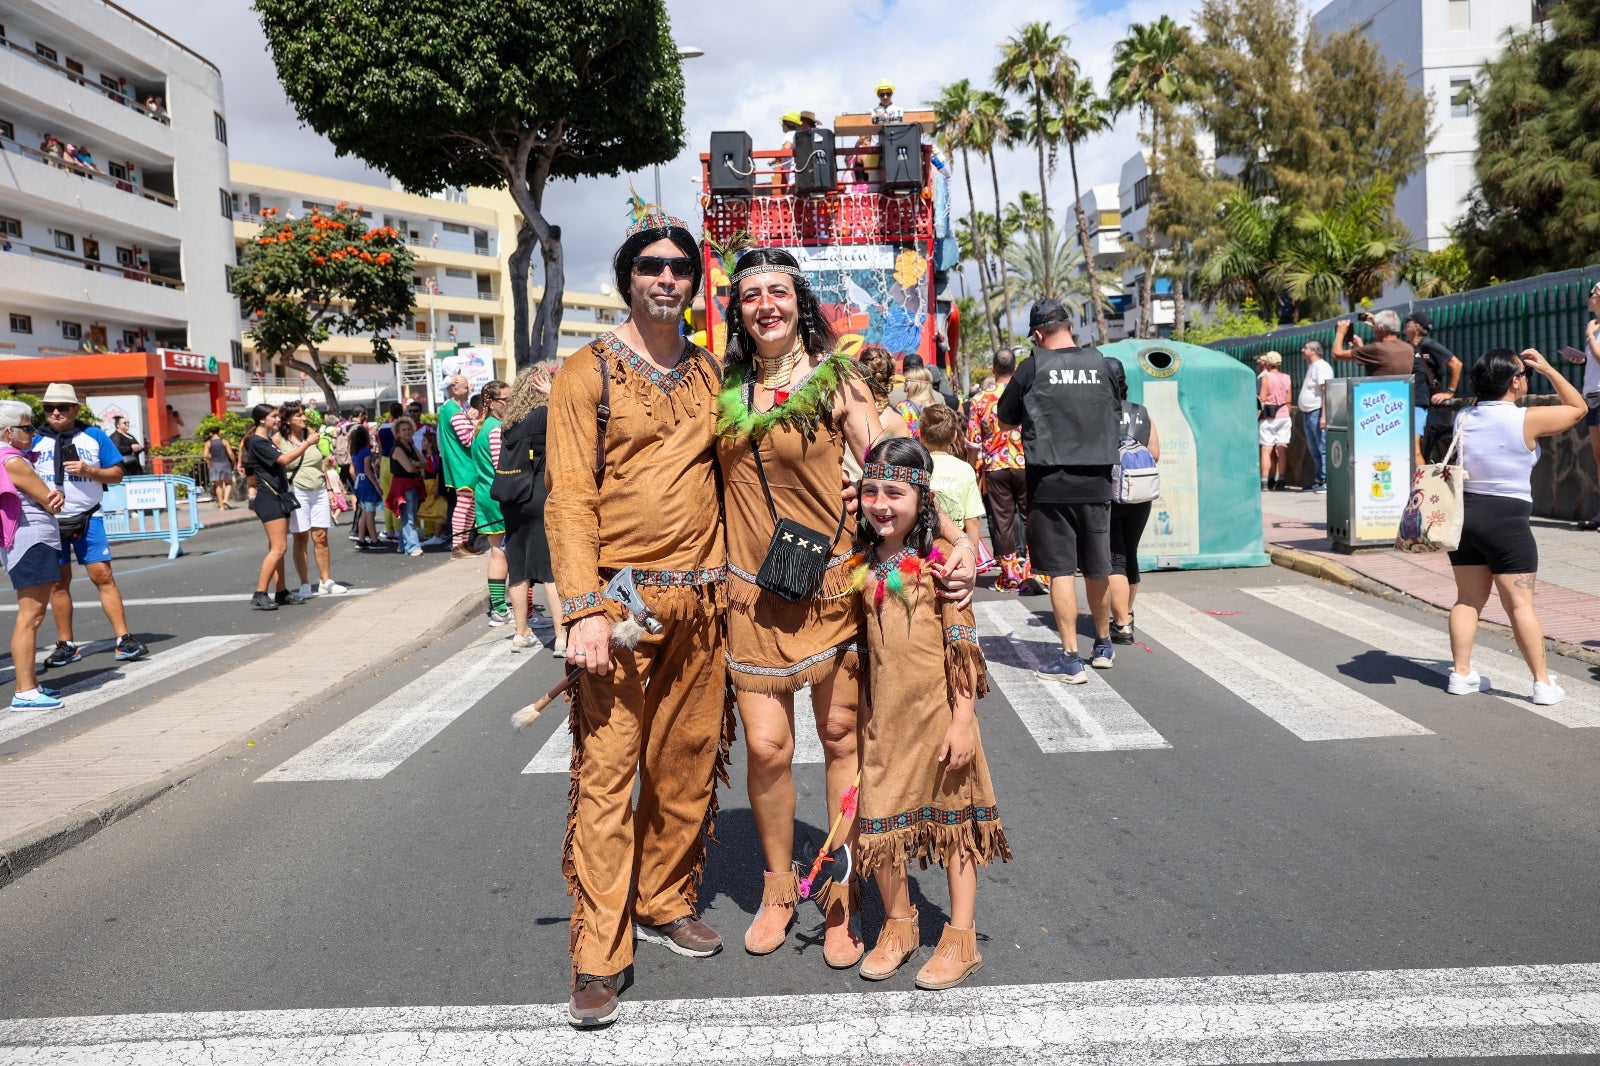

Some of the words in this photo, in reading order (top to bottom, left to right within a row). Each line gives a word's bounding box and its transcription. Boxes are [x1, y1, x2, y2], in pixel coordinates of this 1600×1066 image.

[1049, 369, 1100, 385] S.W.A.T.
[224, 388, 242, 400] PAR
[1362, 393, 1387, 408] Keep
[1360, 412, 1381, 430] your
[1384, 400, 1403, 415] City
[1375, 419, 1400, 436] Clean
[38, 447, 93, 465] HARD
